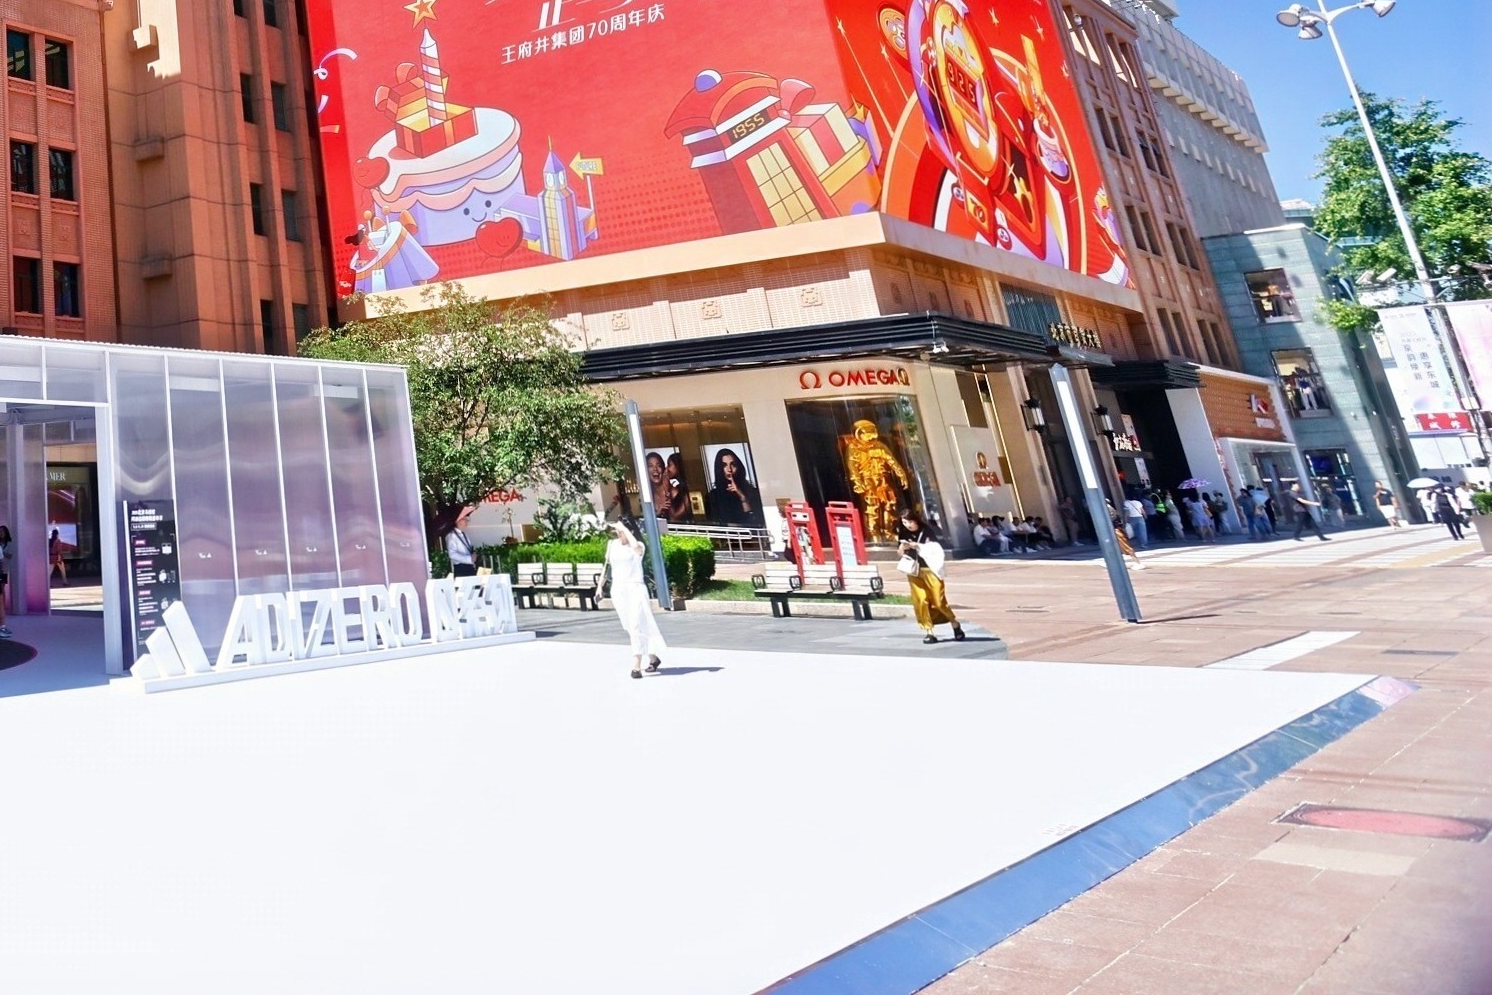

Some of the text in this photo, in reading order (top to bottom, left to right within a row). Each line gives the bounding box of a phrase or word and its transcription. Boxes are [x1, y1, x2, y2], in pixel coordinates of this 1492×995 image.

[501, 4, 665, 64] 王府井集团70周年庆
[732, 112, 765, 139] 1955
[828, 369, 900, 388] OMEGA
[215, 581, 423, 671] ADIZERO
